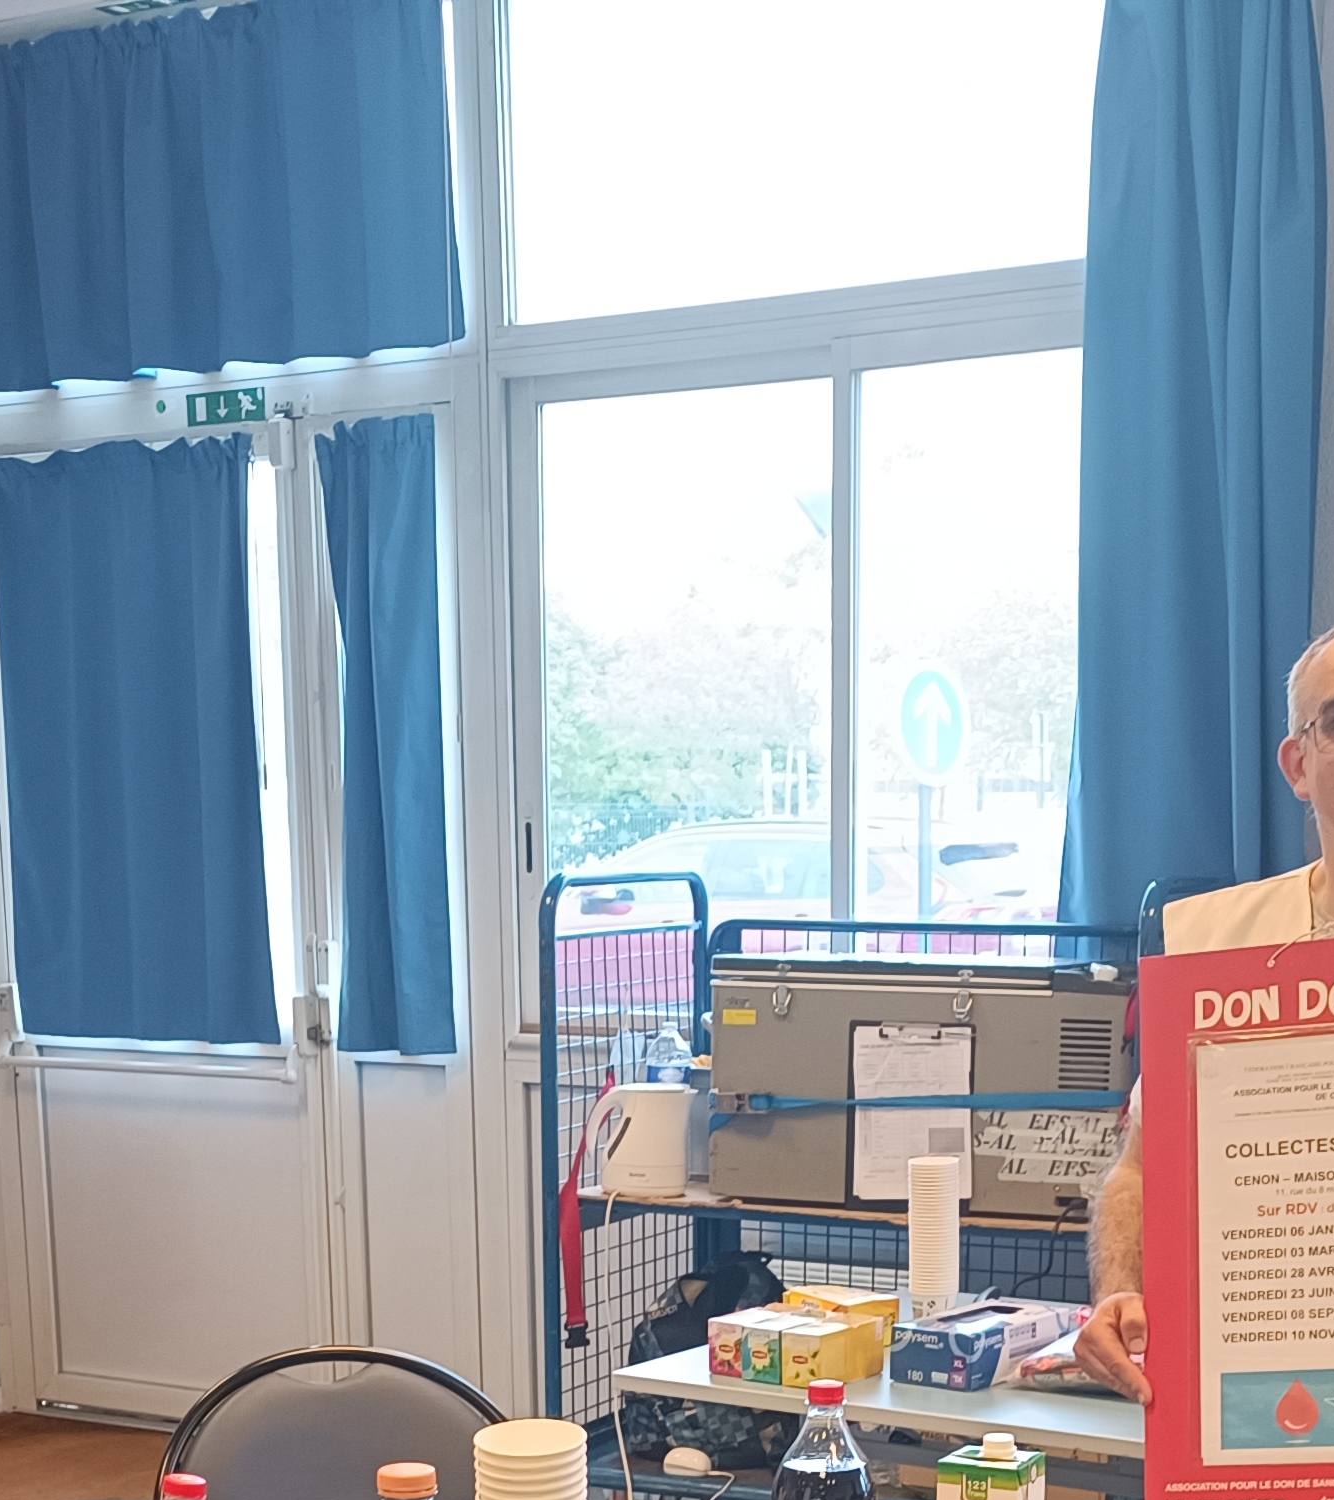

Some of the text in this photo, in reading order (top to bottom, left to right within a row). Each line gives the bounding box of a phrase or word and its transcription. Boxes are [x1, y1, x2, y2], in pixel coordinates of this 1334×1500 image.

[1194, 985, 1280, 1030] DON
[1234, 1085, 1292, 1097] ASSOCIATION
[1294, 1083, 1318, 1093] POUR
[1320, 1081, 1331, 1090] LE
[1315, 1092, 1328, 1101] DE
[1000, 1158, 1028, 1175] AL
[1234, 1174, 1280, 1187] CENON
[1306, 1185, 1317, 1195] du
[1257, 1204, 1281, 1217] Sur
[1285, 1202, 1318, 1215] RDV
[1222, 1227, 1286, 1240] VENDREDI
[1290, 1226, 1304, 1236] 06
[1222, 1248, 1286, 1261] VENDREDI
[1290, 1247, 1304, 1257] 03
[1222, 1269, 1286, 1281] VENDREDI
[1290, 1268, 1304, 1278] 28
[1222, 1289, 1286, 1302] VENDREDI
[1290, 1288, 1304, 1299] 23
[1222, 1310, 1286, 1322] VENDREDI
[1290, 1309, 1304, 1320] 08
[895, 1331, 938, 1344] polysem
[1222, 1331, 1286, 1343] VENDREDI
[1292, 1330, 1305, 1340] 10
[953, 1360, 964, 1368] XL
[907, 1370, 923, 1382] 180
[967, 1481, 987, 1491] 123
[1165, 1481, 1227, 1492] ASSOCIATION
[1230, 1480, 1257, 1490] POUR
[1259, 1480, 1271, 1489] LE
[1273, 1480, 1294, 1489] DON
[1297, 1478, 1310, 1488] DE
